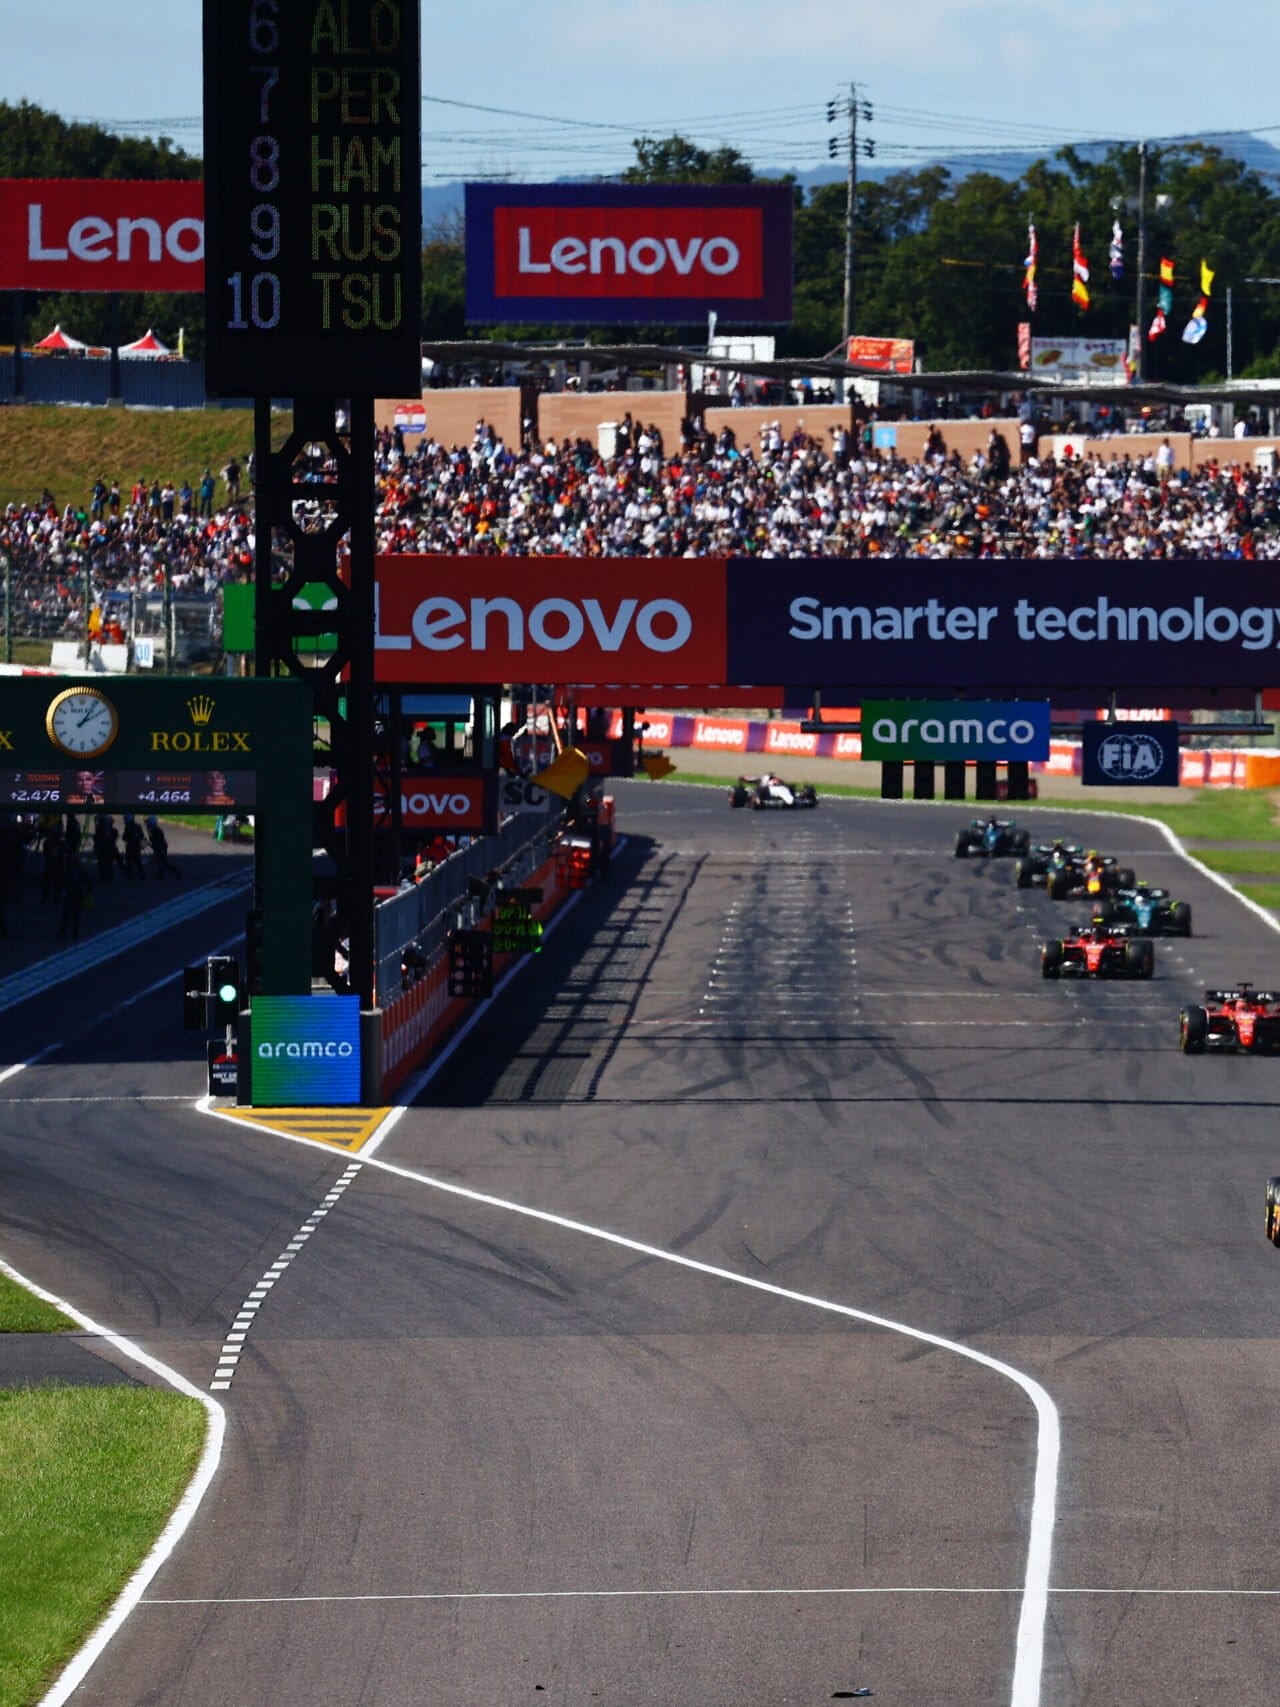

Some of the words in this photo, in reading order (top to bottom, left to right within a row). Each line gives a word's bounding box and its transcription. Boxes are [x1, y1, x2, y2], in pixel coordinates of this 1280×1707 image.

[250, 0, 280, 54] 6
[311, 0, 400, 54] ALO
[250, 67, 280, 124] 7
[311, 67, 400, 124] PER
[250, 135, 280, 192] 8
[311, 135, 400, 192] HAM
[28, 204, 204, 262] Leno
[250, 203, 281, 260] 9
[311, 203, 400, 260] RUS
[519, 227, 739, 275] Lenovo
[226, 271, 281, 329] 10
[311, 271, 400, 329] TSU
[789, 596, 998, 640] Smarter
[151, 732, 251, 751] ROLEX
[696, 720, 744, 745] Lenovo
[769, 729, 816, 750] Lenovo
[872, 718, 1035, 744] aramco
[10, 790, 60, 801] +2.476
[138, 791, 190, 802] +4.464
[503, 782, 545, 806] SC
[258, 1041, 353, 1058] aramco
